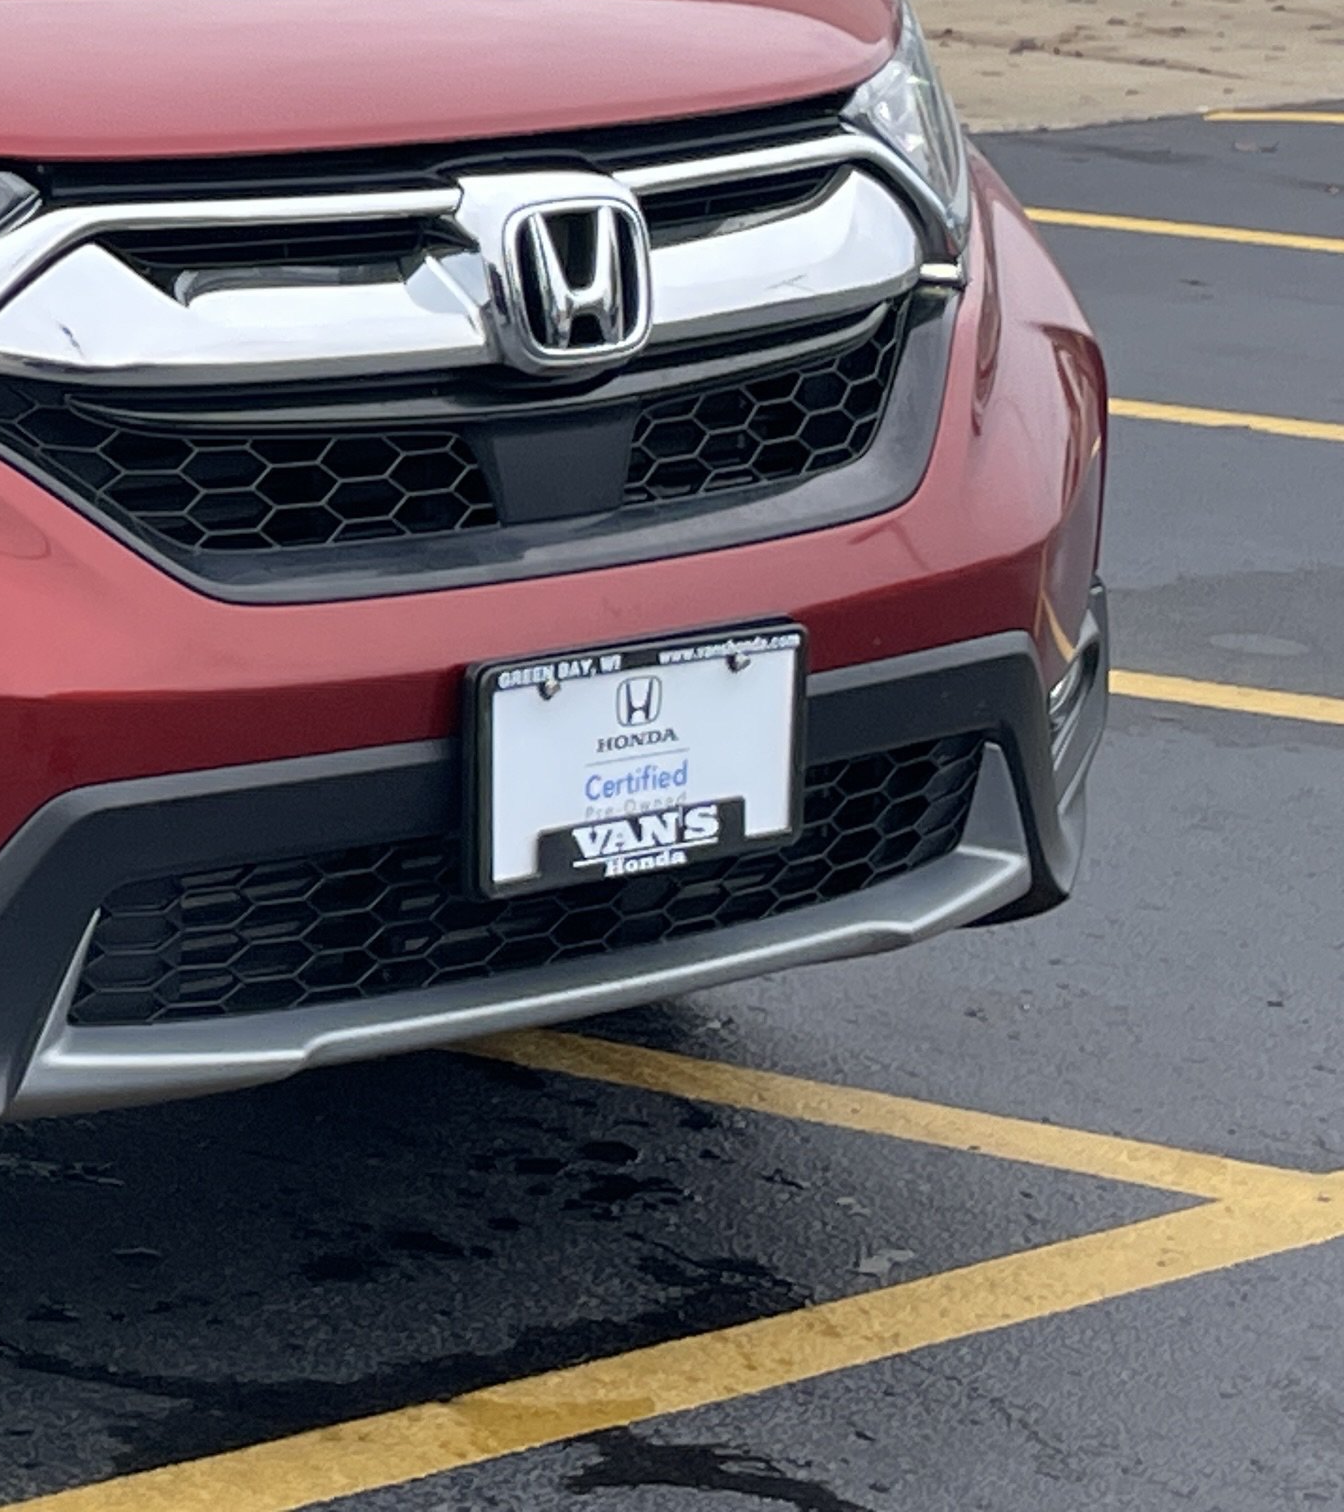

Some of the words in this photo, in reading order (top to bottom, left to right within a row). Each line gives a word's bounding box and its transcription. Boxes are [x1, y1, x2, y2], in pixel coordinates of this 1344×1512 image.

[498, 664, 554, 689] GREEN
[596, 728, 679, 753] HONDA
[585, 759, 688, 801] Certified
[604, 850, 688, 878] Honda
